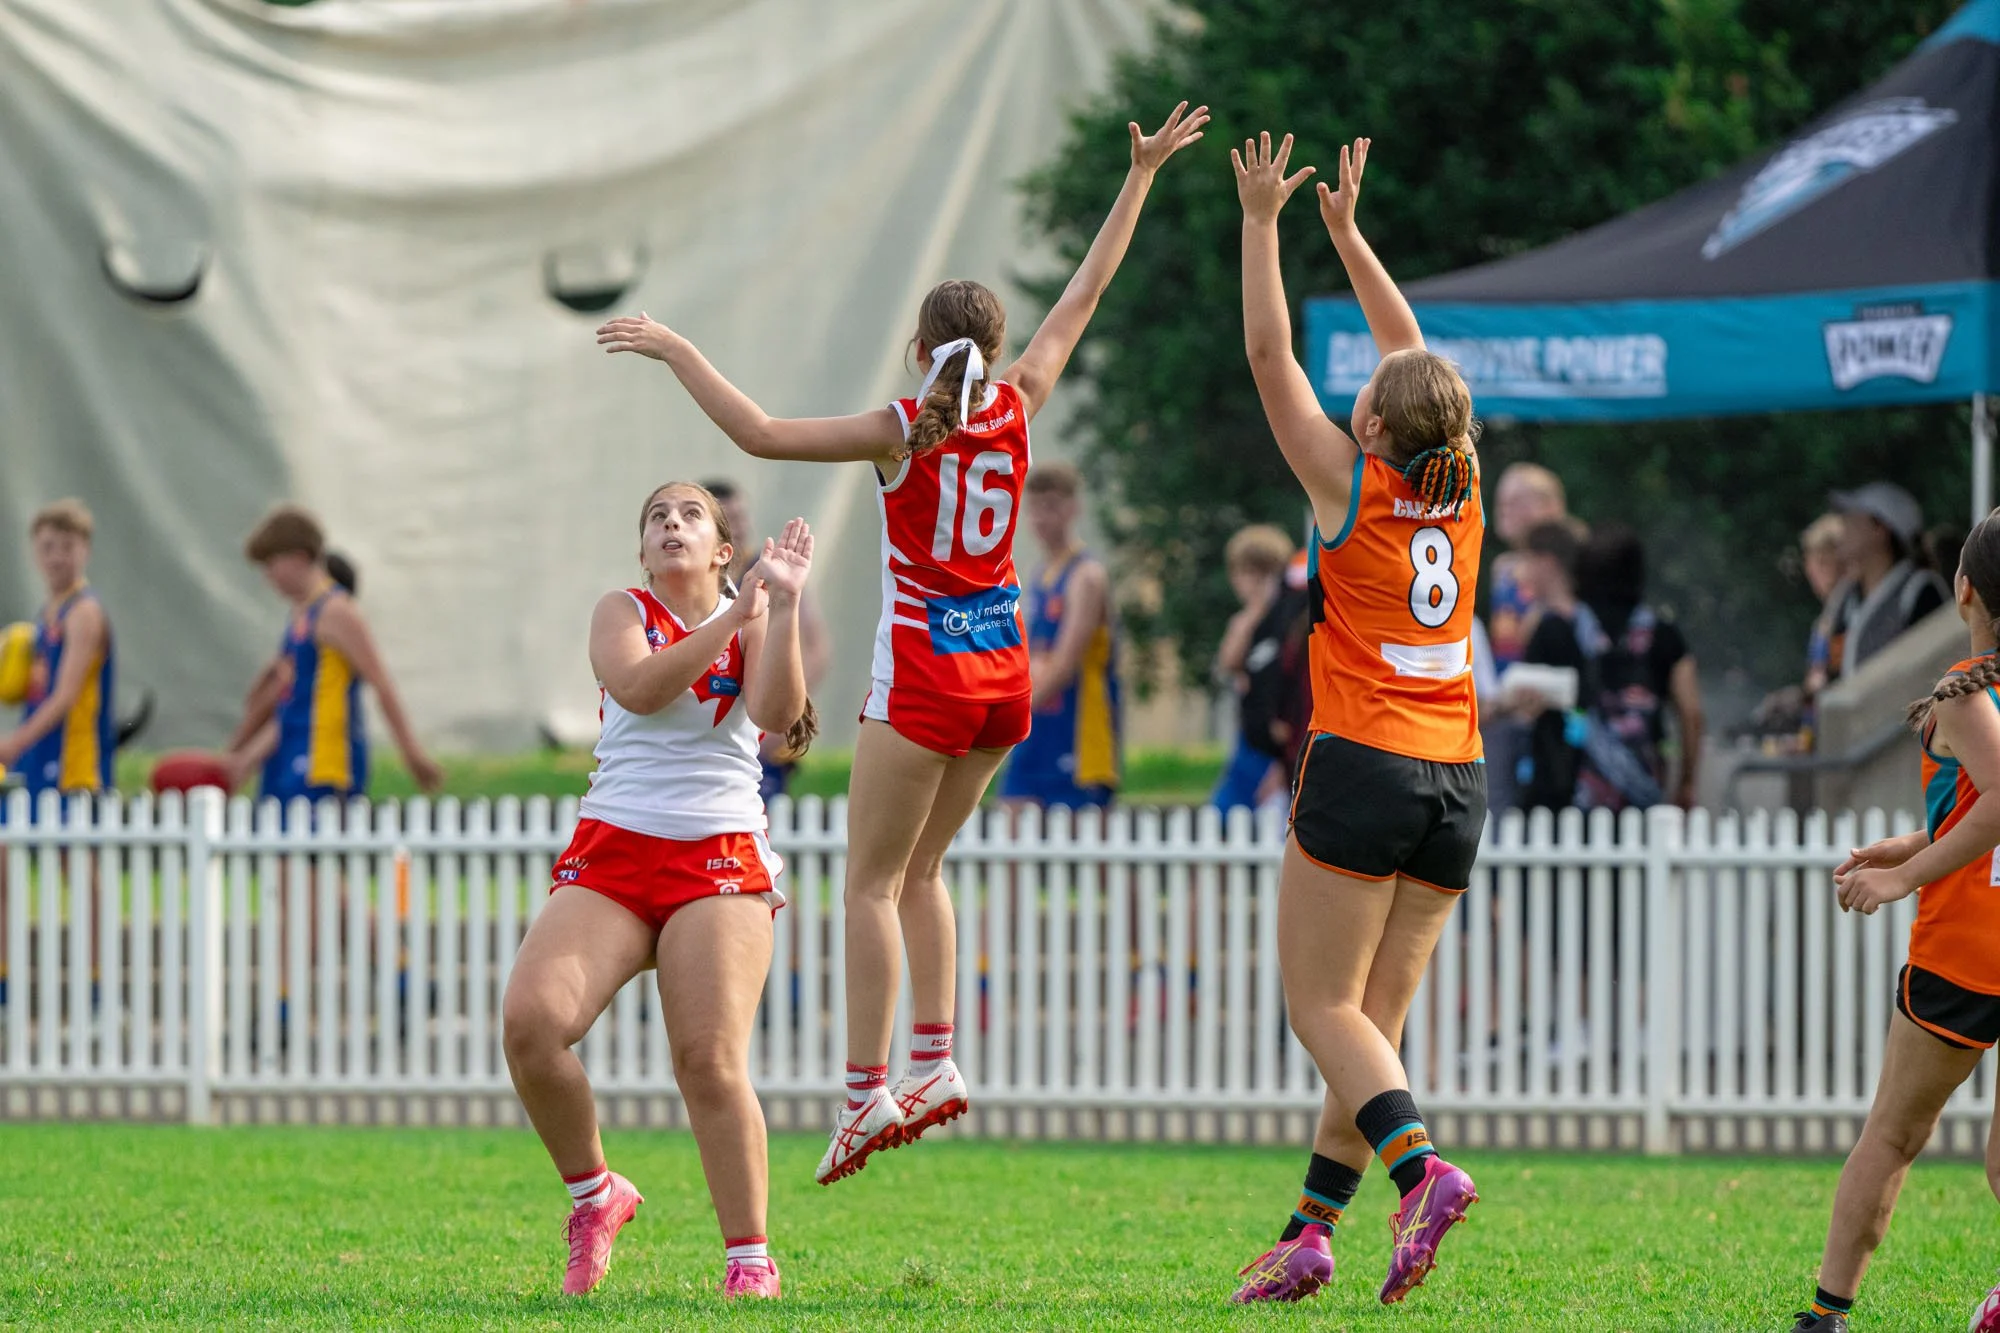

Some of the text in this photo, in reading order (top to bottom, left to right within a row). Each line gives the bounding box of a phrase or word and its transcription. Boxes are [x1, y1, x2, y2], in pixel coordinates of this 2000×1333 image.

[989, 409, 1015, 430] SWANS
[931, 451, 1013, 561] 16
[1409, 526, 1459, 629] 8
[991, 618, 1010, 629] nest
[1407, 1132, 1427, 1146] IS
